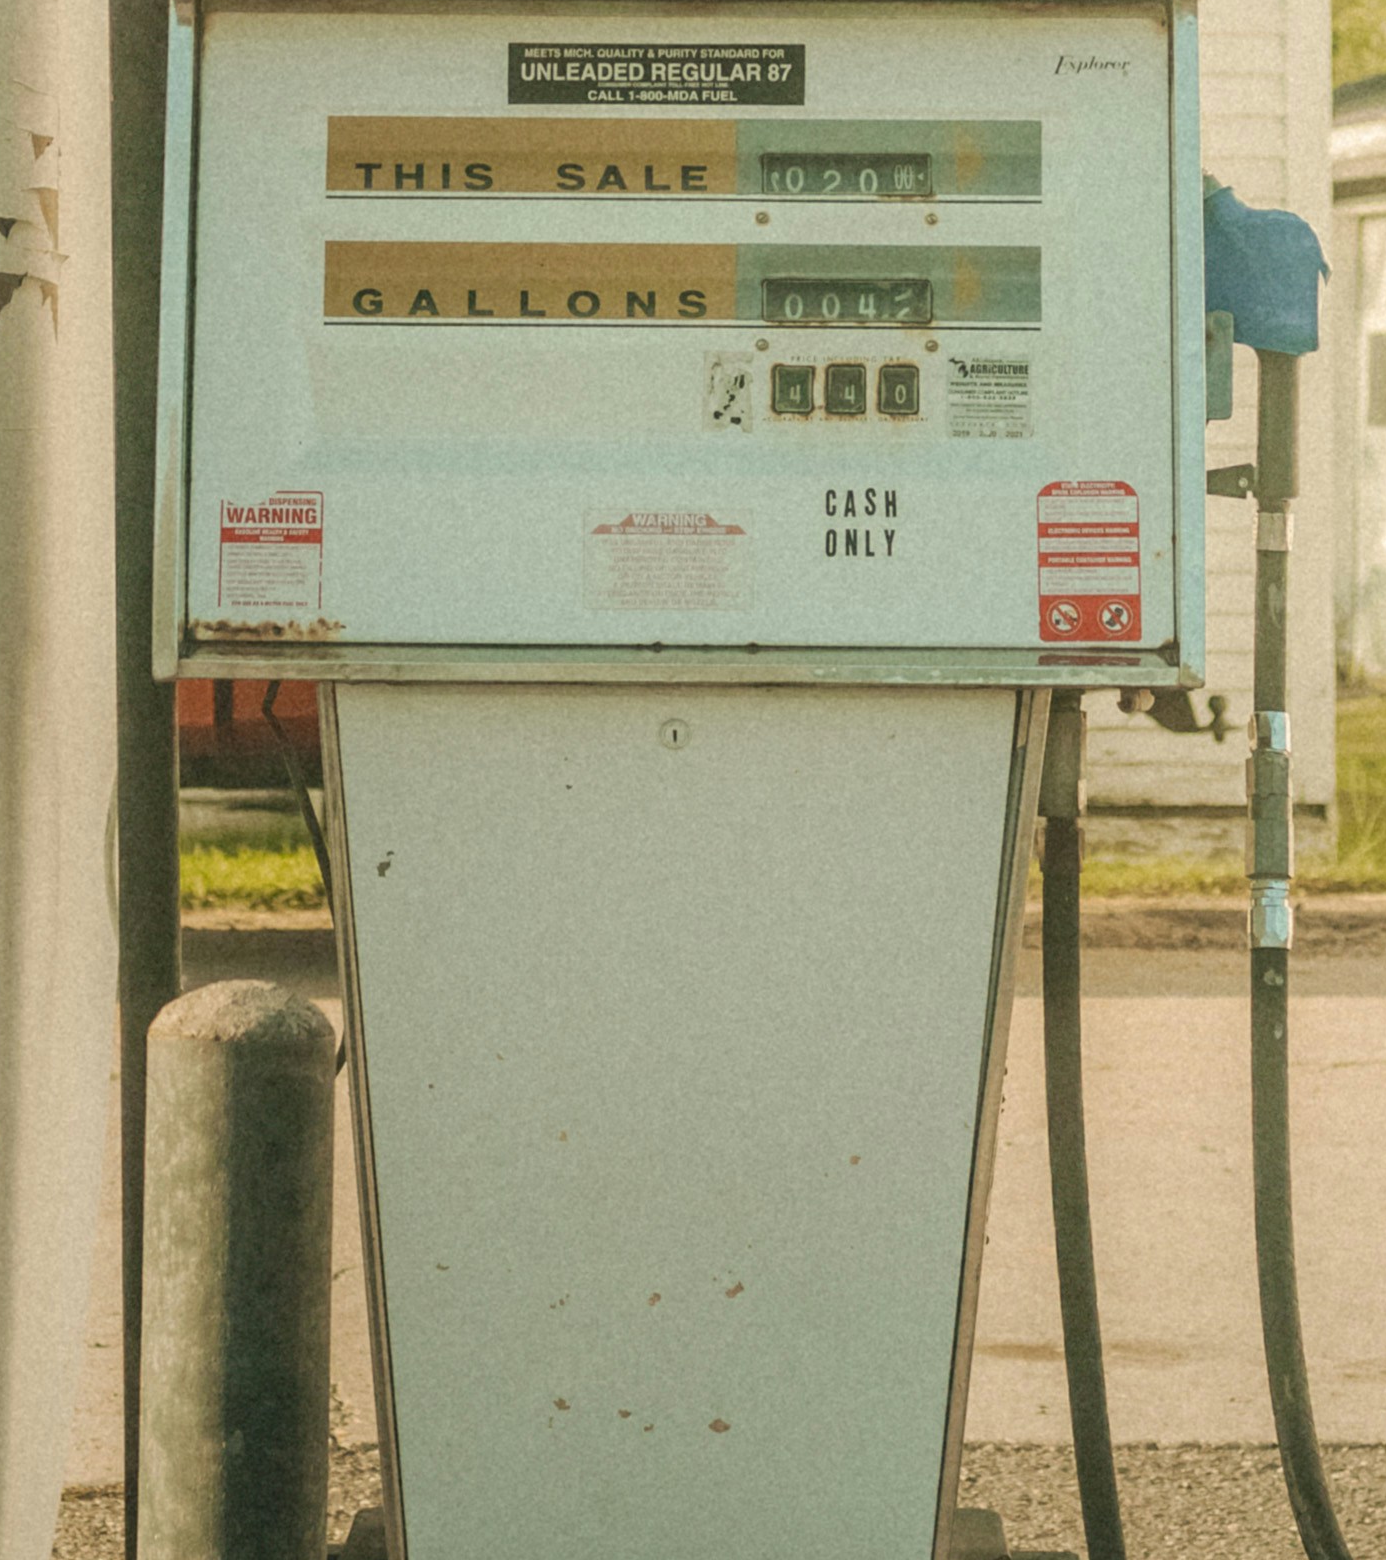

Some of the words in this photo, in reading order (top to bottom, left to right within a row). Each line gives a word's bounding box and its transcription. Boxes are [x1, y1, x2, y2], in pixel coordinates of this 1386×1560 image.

[524, 48, 562, 59] MEETS
[563, 48, 594, 59] MICH.
[597, 48, 645, 59] QUALITY
[647, 48, 655, 59] &
[657, 48, 699, 59] PURITY
[700, 48, 760, 59] STANDARD
[762, 48, 785, 59] FOR
[520, 62, 645, 82] UNLEADED
[650, 62, 762, 82] REGULAR
[767, 62, 793, 82] 87
[1054, 55, 1131, 75] Explorer
[587, 90, 624, 102] CALL
[628, 90, 699, 102] 1-800-MDA
[702, 90, 739, 102] FUEL
[354, 162, 494, 191] THIS
[555, 163, 709, 192] SALE
[352, 288, 709, 319] GALLONS
[268, 497, 317, 506] DISPENSING
[825, 487, 897, 518] CASH
[226, 507, 318, 525] WARNING
[632, 513, 708, 527] WARNING
[825, 528, 896, 558] ONLY
